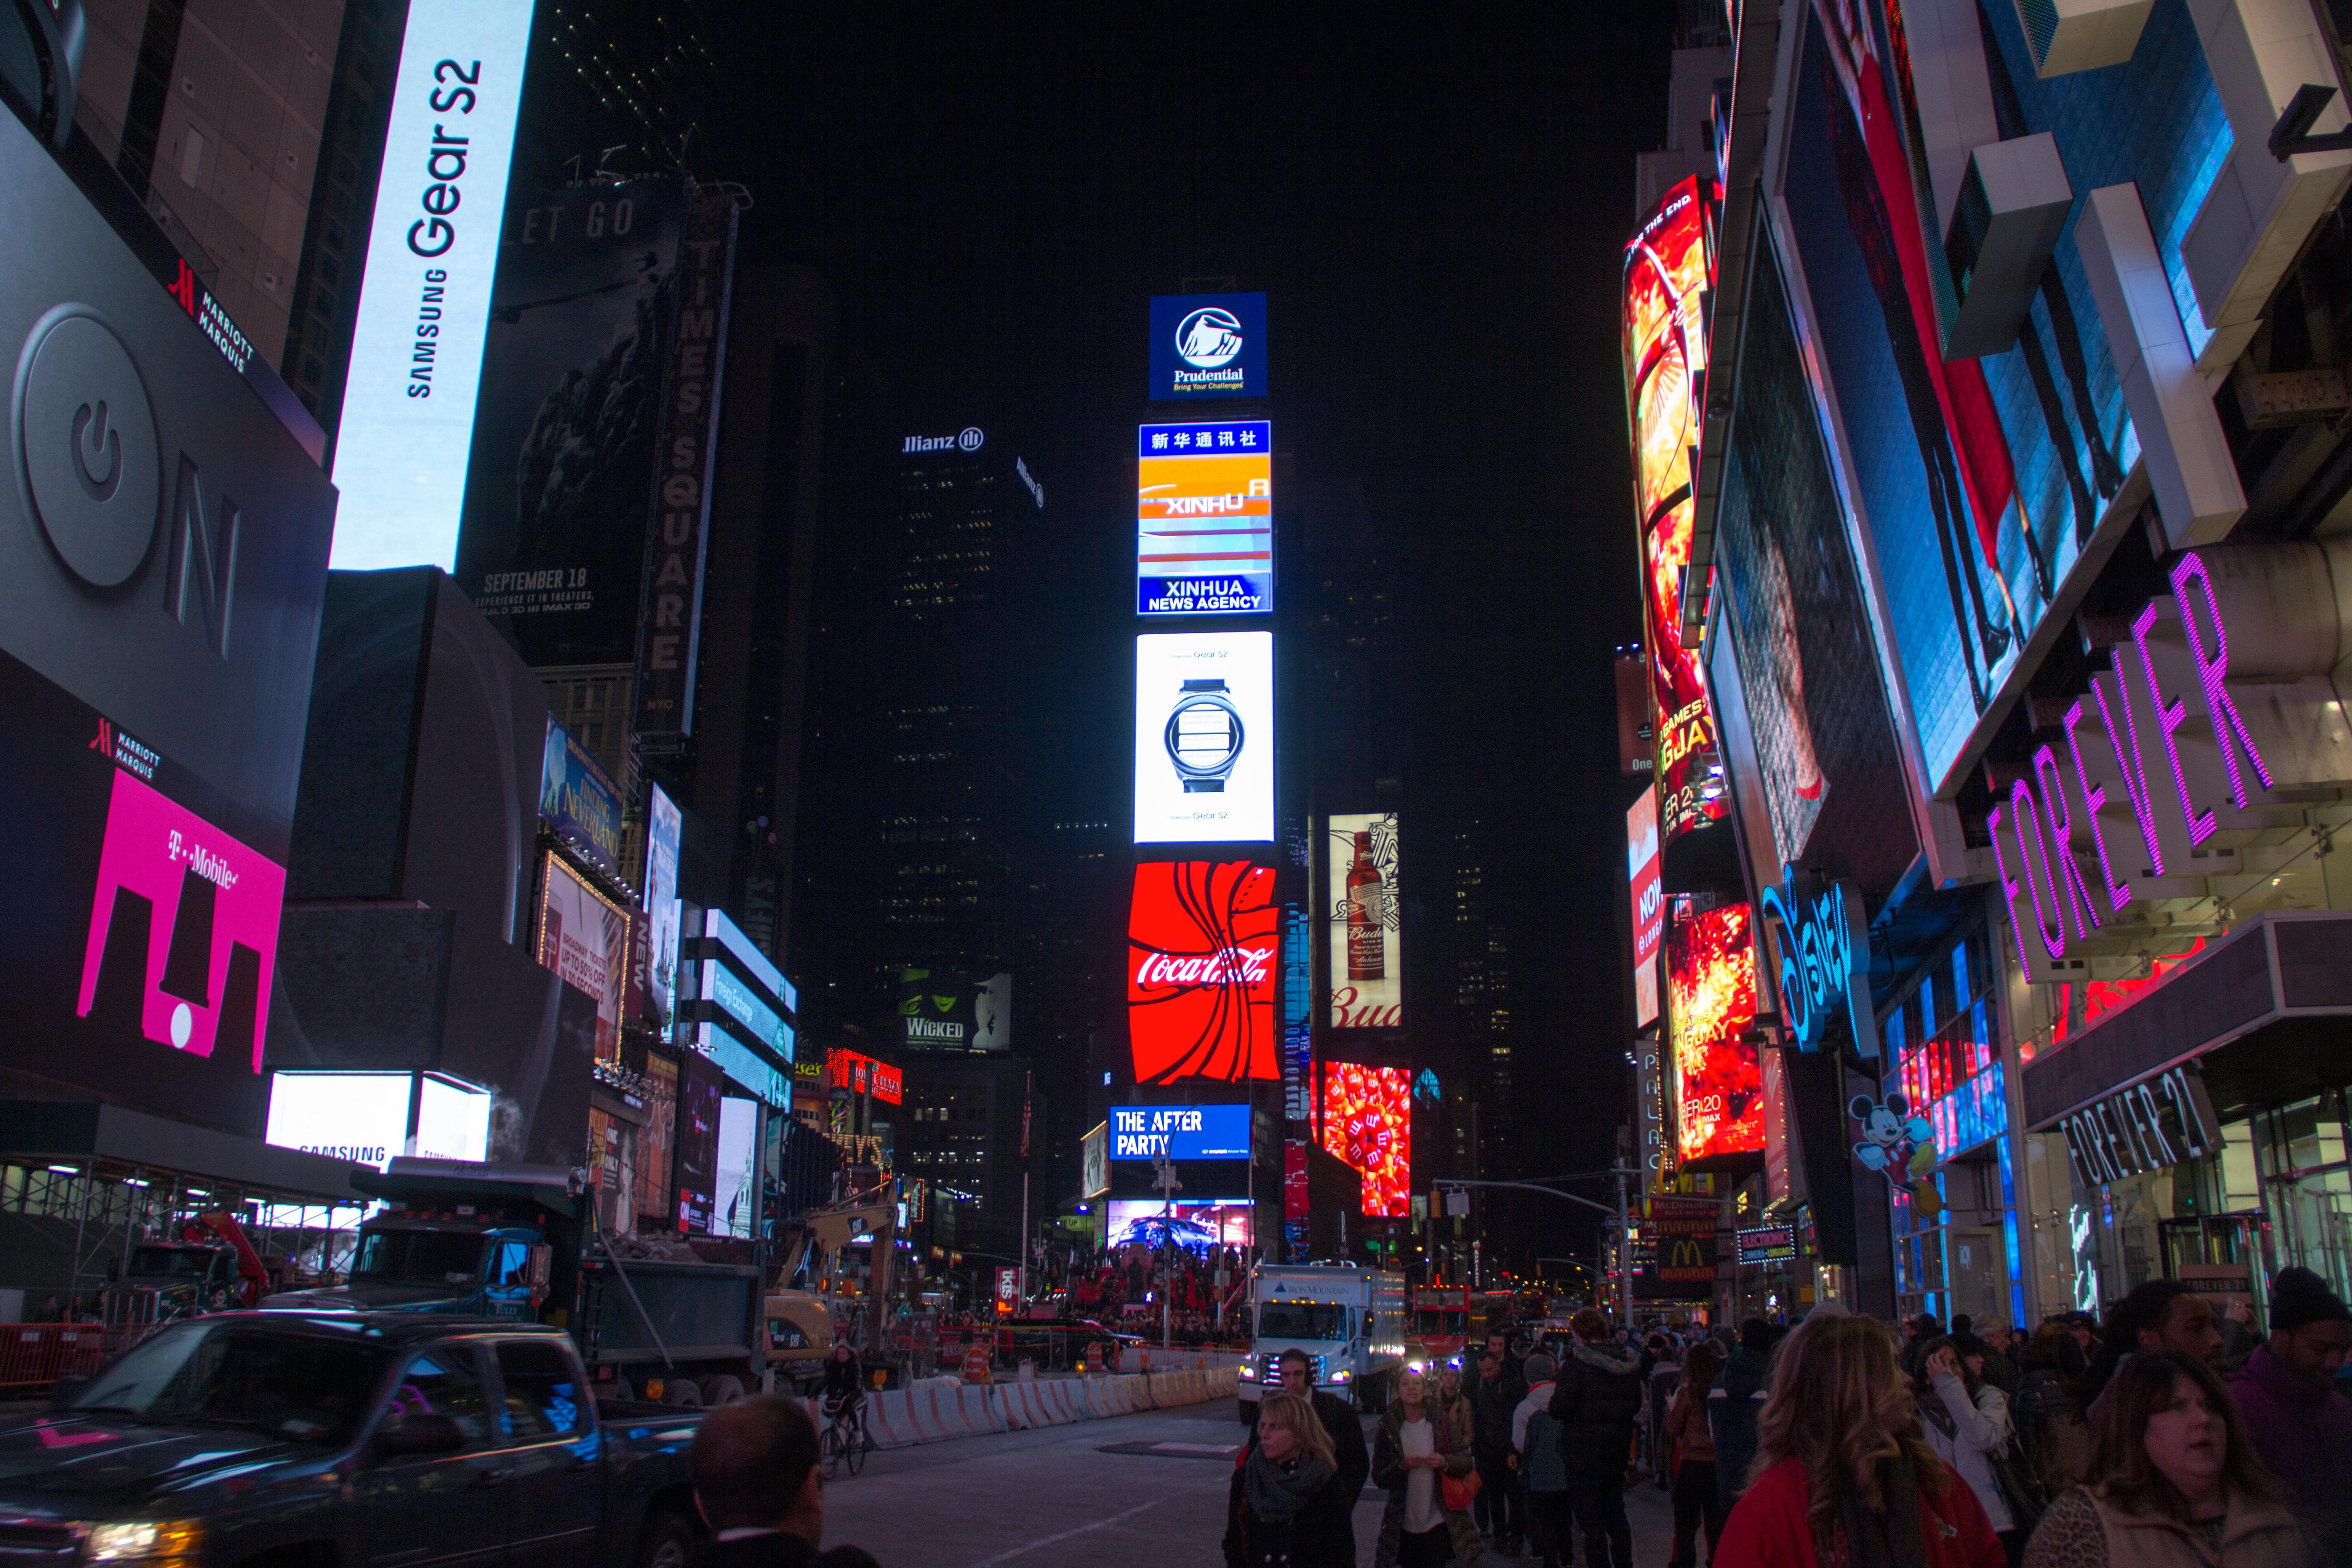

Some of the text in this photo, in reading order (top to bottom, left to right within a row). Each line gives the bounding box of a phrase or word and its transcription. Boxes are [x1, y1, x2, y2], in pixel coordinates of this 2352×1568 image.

[407, 59, 481, 398] SAMSUNG Gear S2
[586, 198, 633, 238] GO
[1645, 213, 1664, 235] THE
[203, 292, 253, 359] MARRIOTT
[199, 312, 245, 374] MARQUIS
[1174, 368, 1243, 383] Prudential
[1174, 383, 1191, 391] Bring
[1152, 430, 1257, 449] 新华通讯社
[651, 240, 720, 671] TIMES SQUARE
[1016, 456, 1036, 495] Allianz
[484, 568, 587, 593] SEPTEMBER 18
[1166, 580, 1244, 597] XINHUA
[527, 593, 536, 603] IT
[539, 593, 547, 603] IN
[542, 603, 572, 611] IMAX
[1149, 595, 1261, 610] NEWS AGENCY
[1194, 651, 1215, 659] Gear
[117, 731, 161, 768] MARRIOTT
[115, 749, 153, 780] MARQUIS
[1986, 551, 2274, 984] FOREVER
[580, 778, 610, 822] FINDING
[564, 782, 618, 857] NEVERLAND
[563, 933, 588, 959] BROADWAY
[589, 951, 607, 971] TICKETS
[633, 920, 649, 992] NEW
[562, 947, 606, 987] UP TO 50% OFF
[1137, 947, 1274, 989] Coca-Cola
[568, 971, 575, 986] 30
[576, 977, 603, 1005] SECONDS
[716, 973, 753, 1023] Foreign Exchange
[880, 1076, 899, 1092] PLAZA
[1704, 1094, 1721, 1112] 20
[1116, 1111, 1202, 1132] THE AFTER
[1701, 1113, 1721, 1123] IMAX
[2060, 1067, 2212, 1191] FOREVER 21
[607, 1127, 618, 1144] ONE
[1117, 1135, 1169, 1155] PARTY
[605, 1154, 618, 1172] ONLY
[853, 1219, 863, 1232] CAT
[1742, 1231, 1791, 1247] ELECTRONICS
[1308, 1286, 1350, 1295] MOUNTAIN
[2188, 1279, 2247, 1291] FOREVER 21
